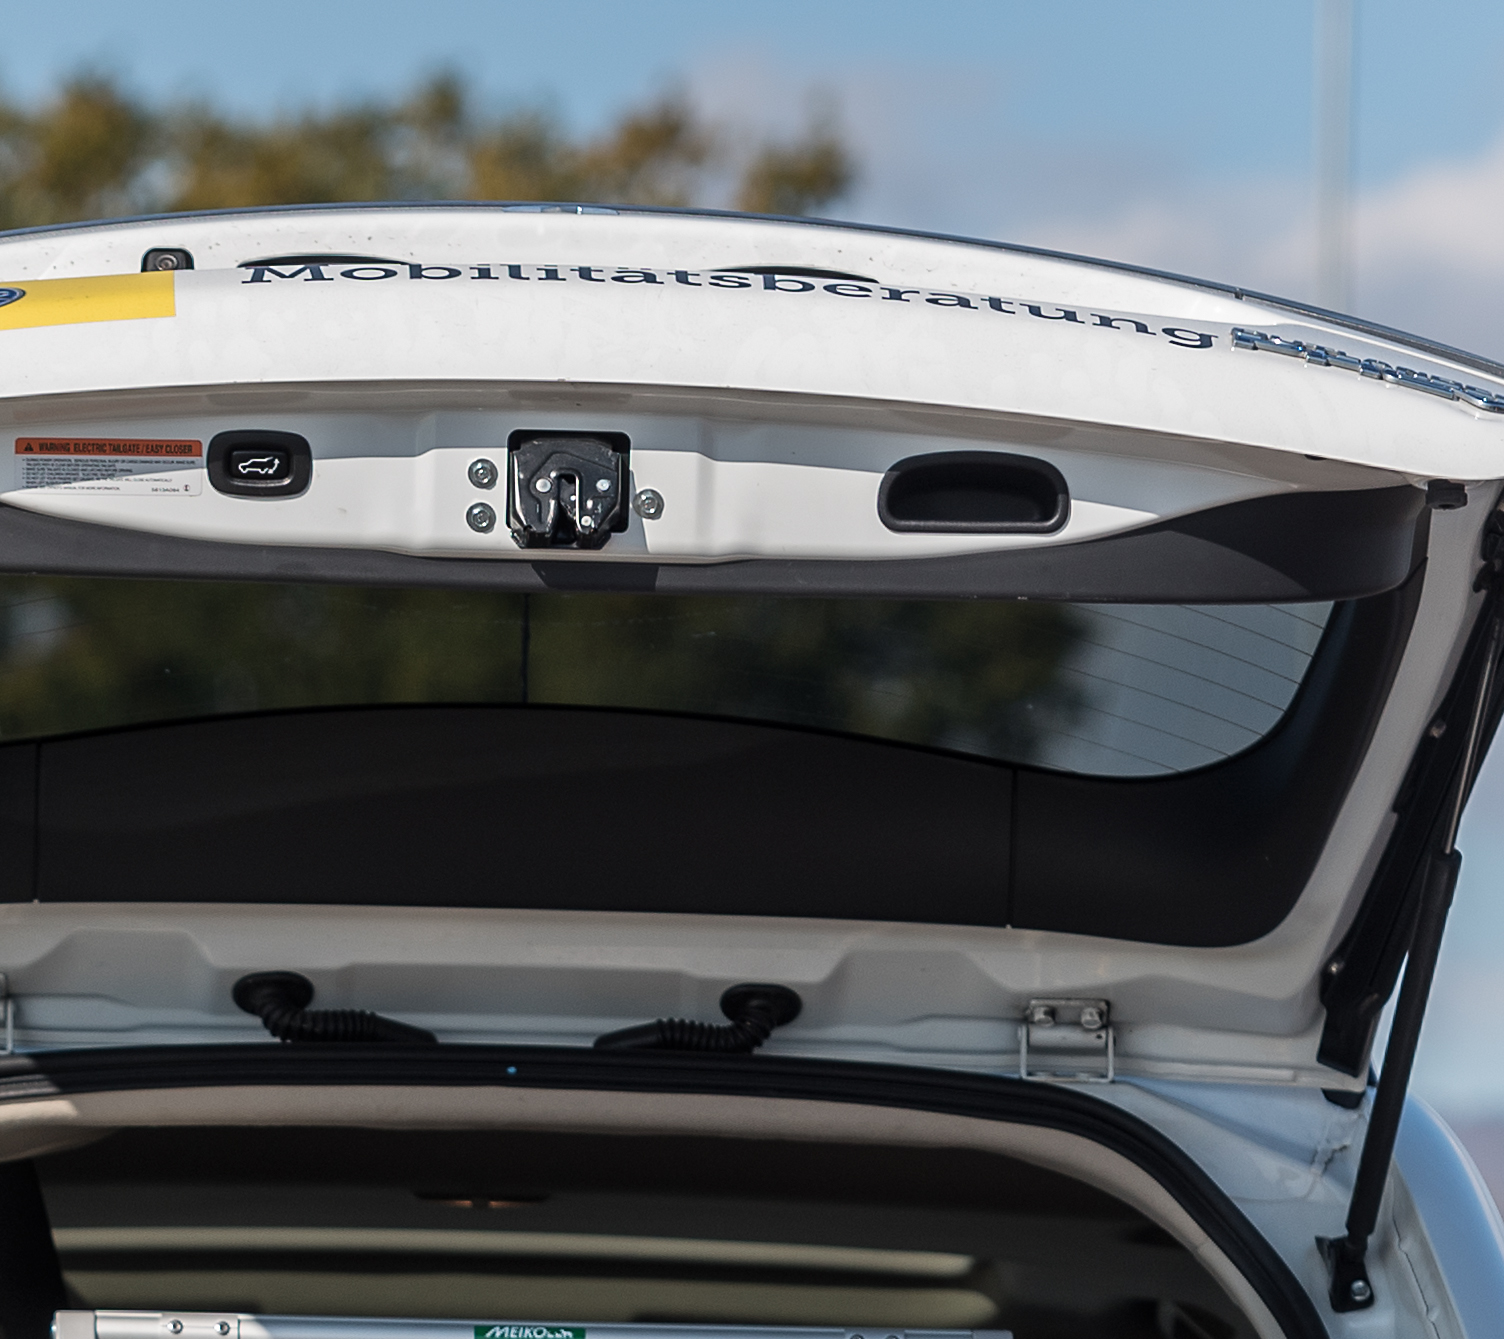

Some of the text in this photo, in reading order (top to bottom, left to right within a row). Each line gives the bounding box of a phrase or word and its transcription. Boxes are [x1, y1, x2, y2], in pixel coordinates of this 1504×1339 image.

[38, 442, 71, 453] WARNING
[73, 443, 107, 454] ELECTRIC
[108, 443, 141, 454] TAILGATE
[145, 444, 165, 454] EASY
[165, 444, 193, 455] CLOSER
[485, 1326, 547, 1339] MEIKO
